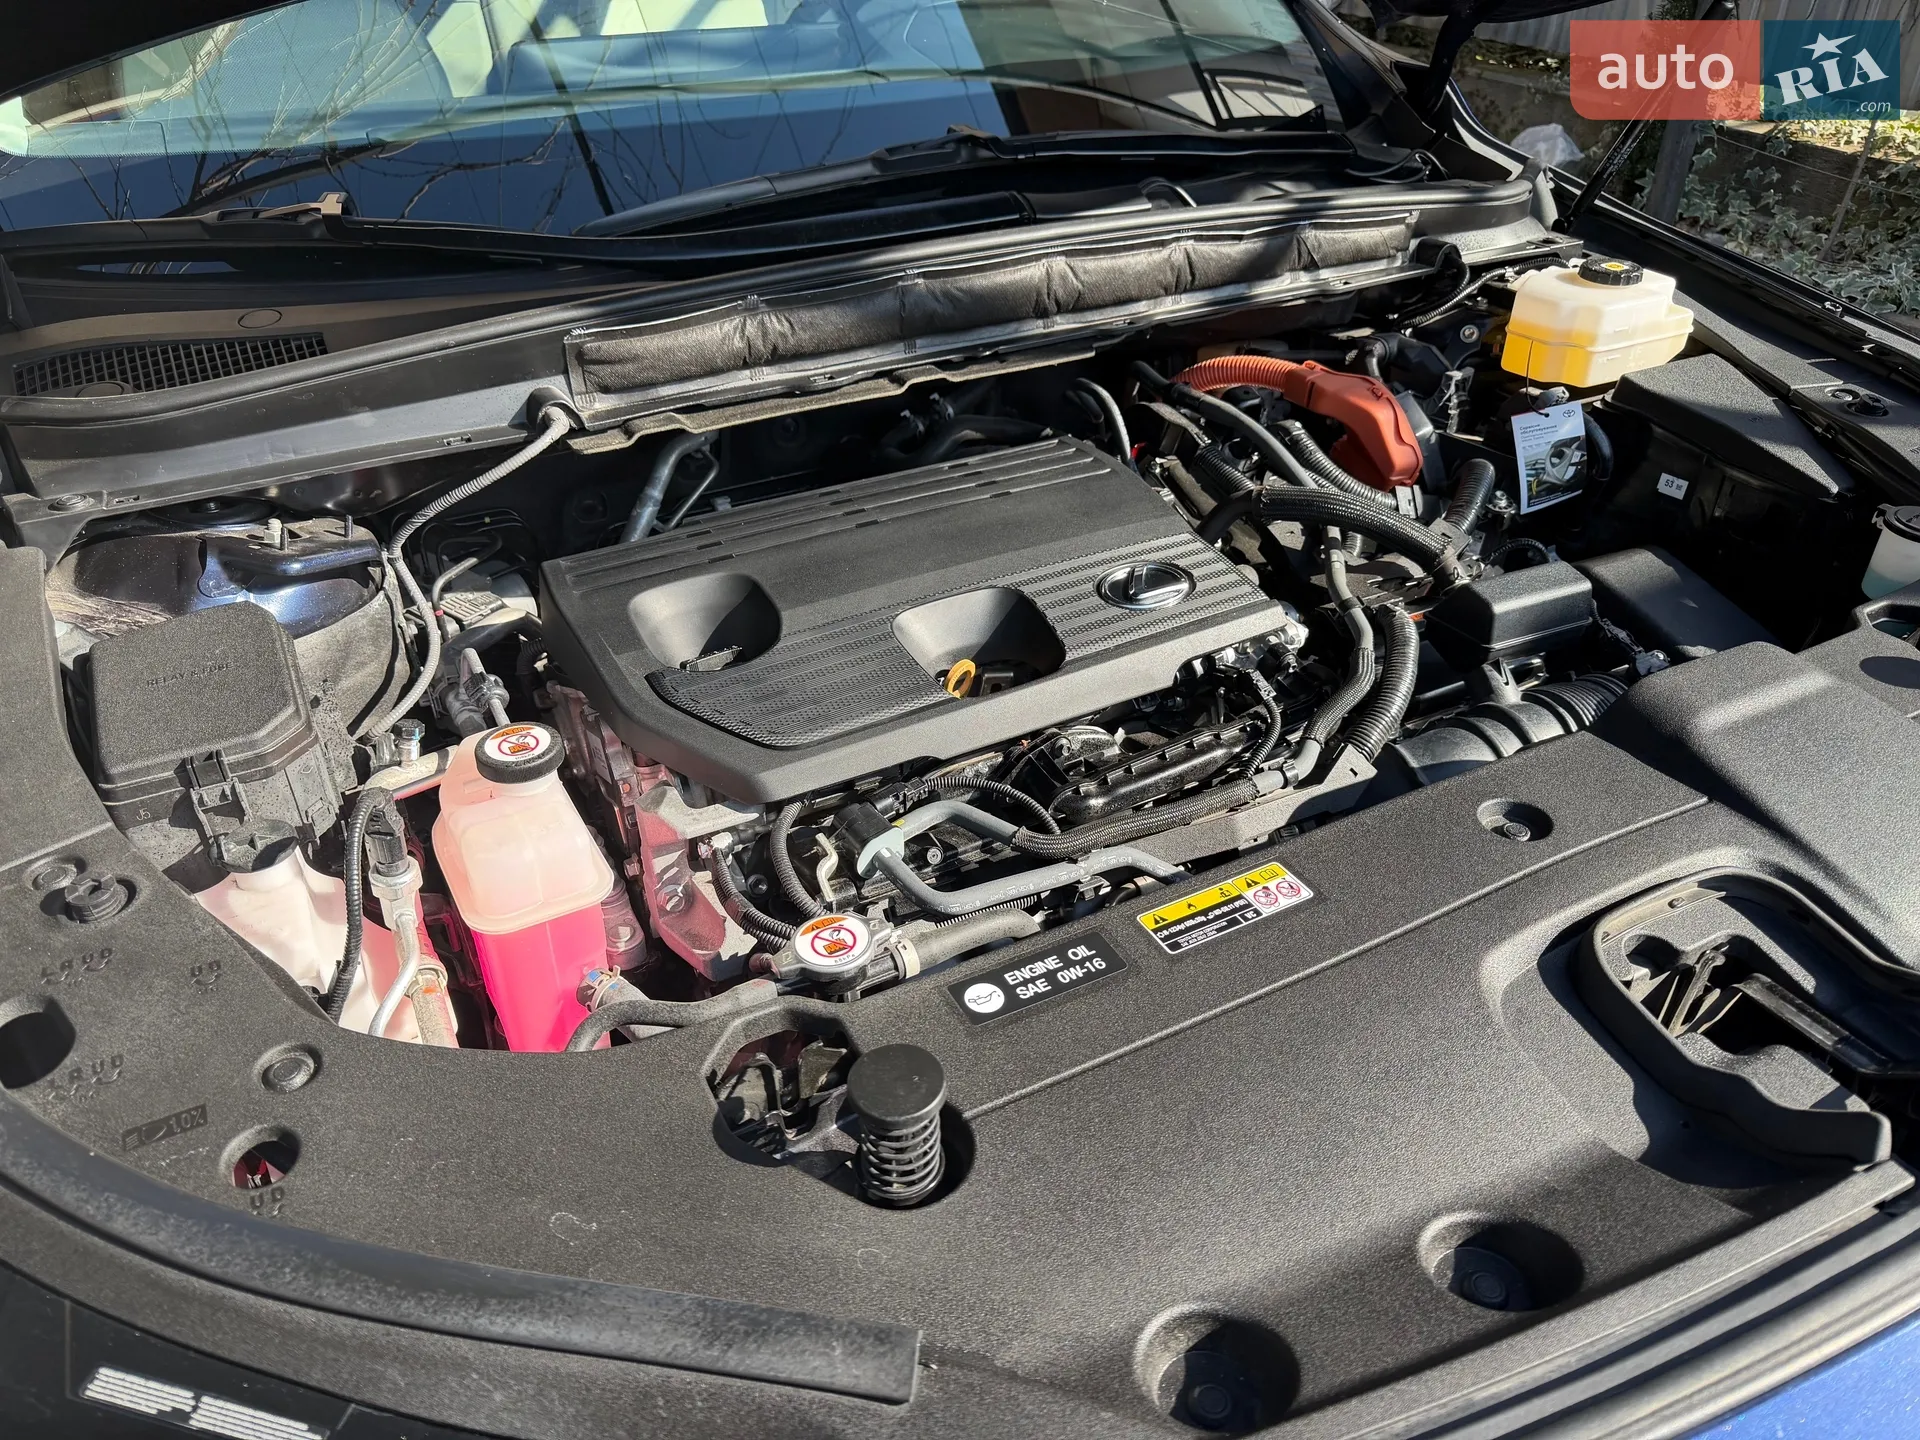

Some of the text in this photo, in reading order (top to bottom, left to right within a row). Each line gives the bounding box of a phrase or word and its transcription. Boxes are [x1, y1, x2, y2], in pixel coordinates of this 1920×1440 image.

[1664, 479, 1675, 489] 53
[1003, 945, 1096, 985] ENGINE OIL
[1016, 957, 1107, 999] SAE 0W-16
